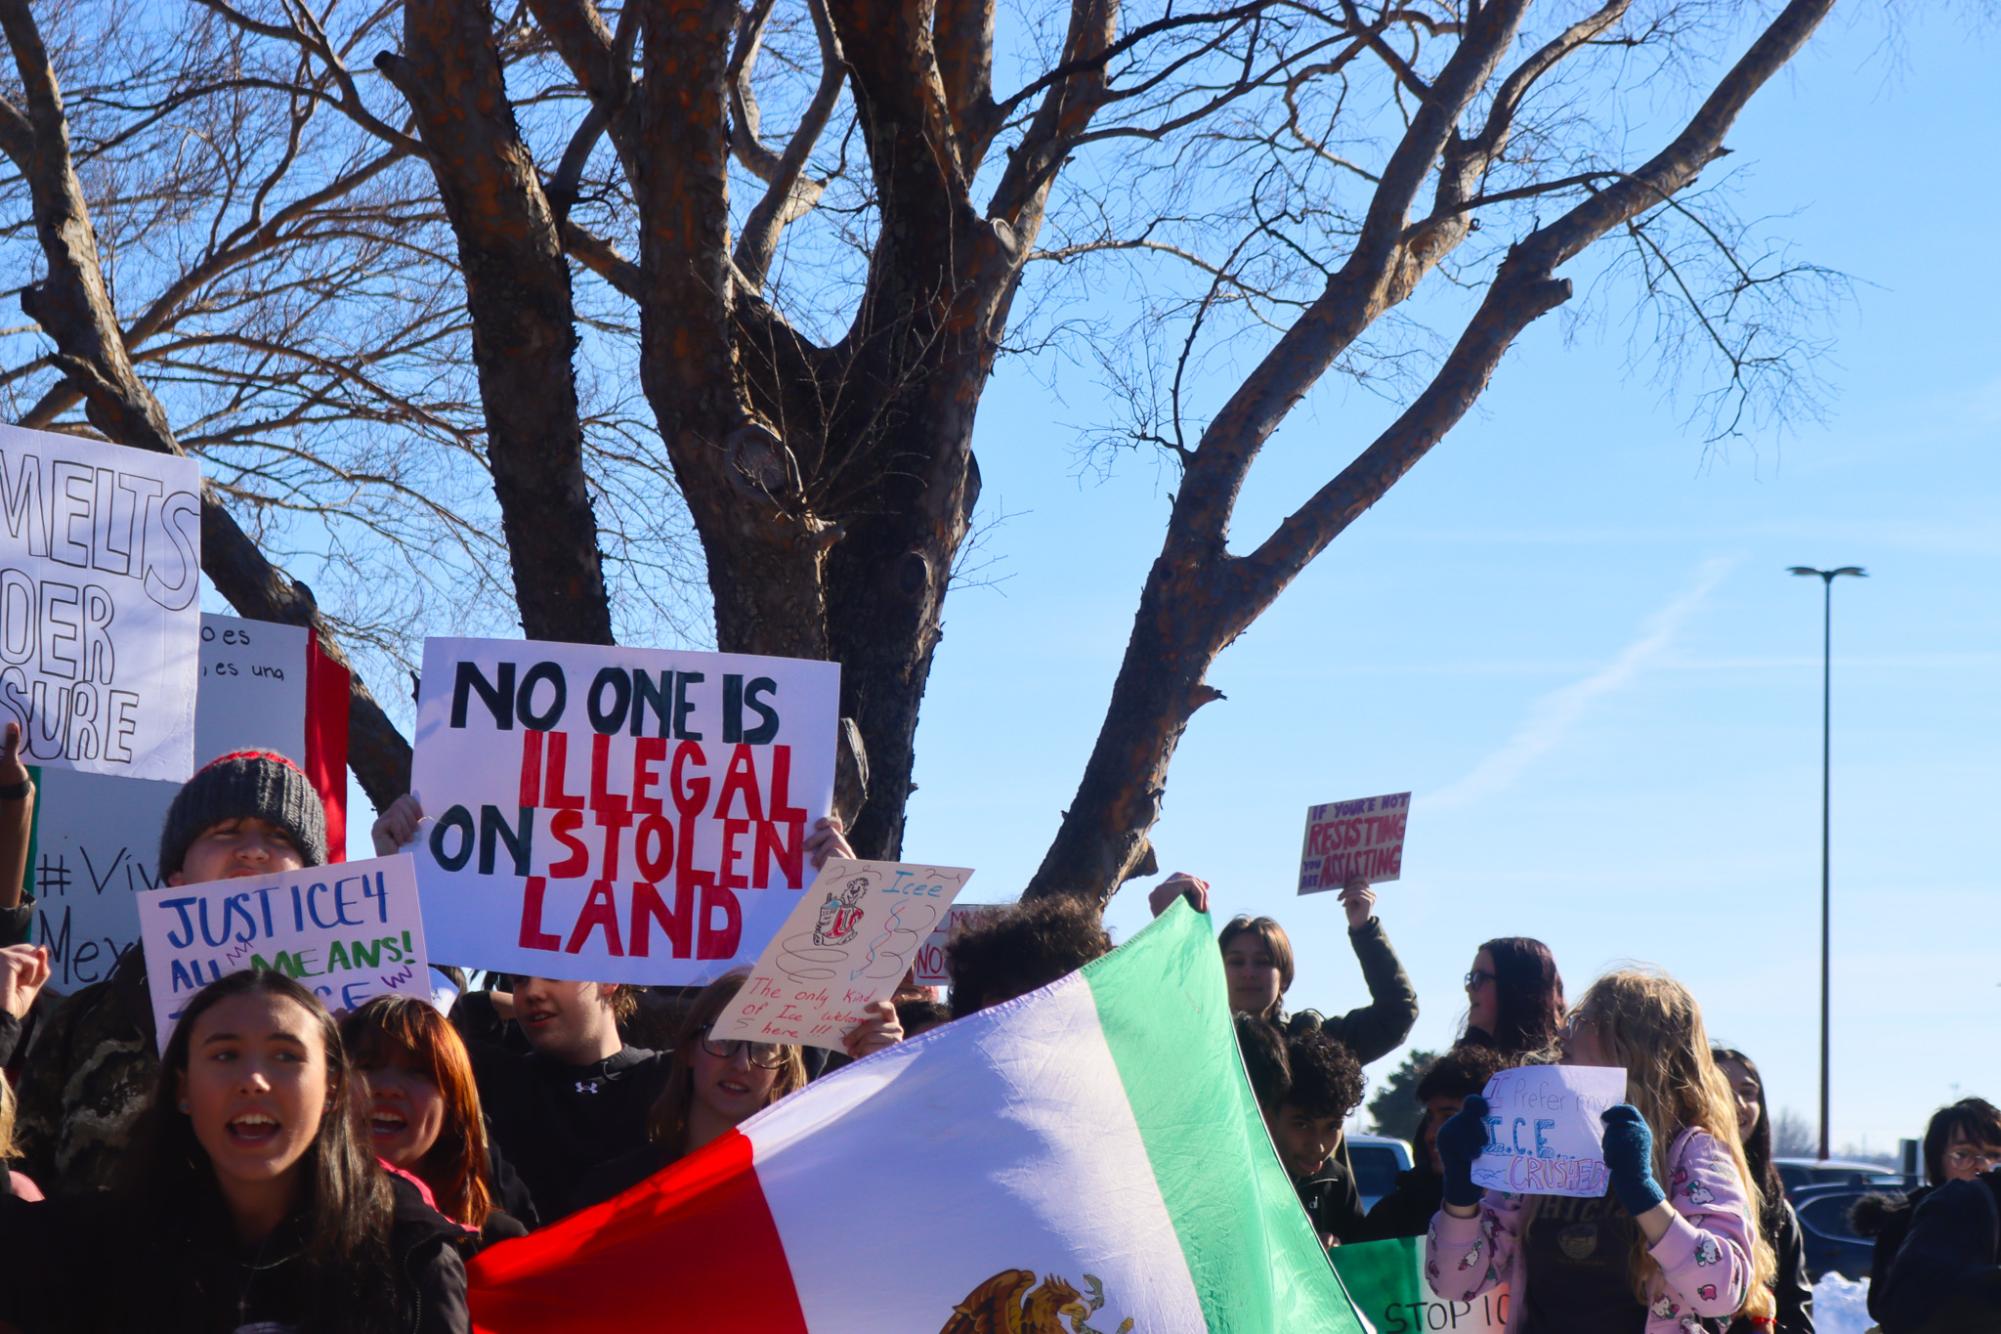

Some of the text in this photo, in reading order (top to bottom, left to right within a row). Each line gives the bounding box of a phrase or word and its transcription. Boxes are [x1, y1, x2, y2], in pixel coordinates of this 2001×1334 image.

[252, 664, 284, 681] una
[450, 661, 780, 744] NO ONE IS
[519, 729, 807, 822] ILLEGAL
[1312, 804, 1328, 820] IF
[1381, 793, 1409, 811] NOT
[429, 804, 803, 889] ON STOLEN
[1307, 813, 1407, 857] RESISTING
[882, 870, 943, 898] Icee
[518, 876, 742, 960] LAND
[250, 930, 417, 981] MEANS!
[750, 976, 782, 999] The
[795, 987, 829, 1010] only
[742, 1002, 768, 1016] of
[776, 1004, 802, 1022] Ice
[762, 1021, 799, 1039] here
[1510, 1156, 1611, 1192] CRUSHED
[1384, 1294, 1511, 1333] STOP IC
